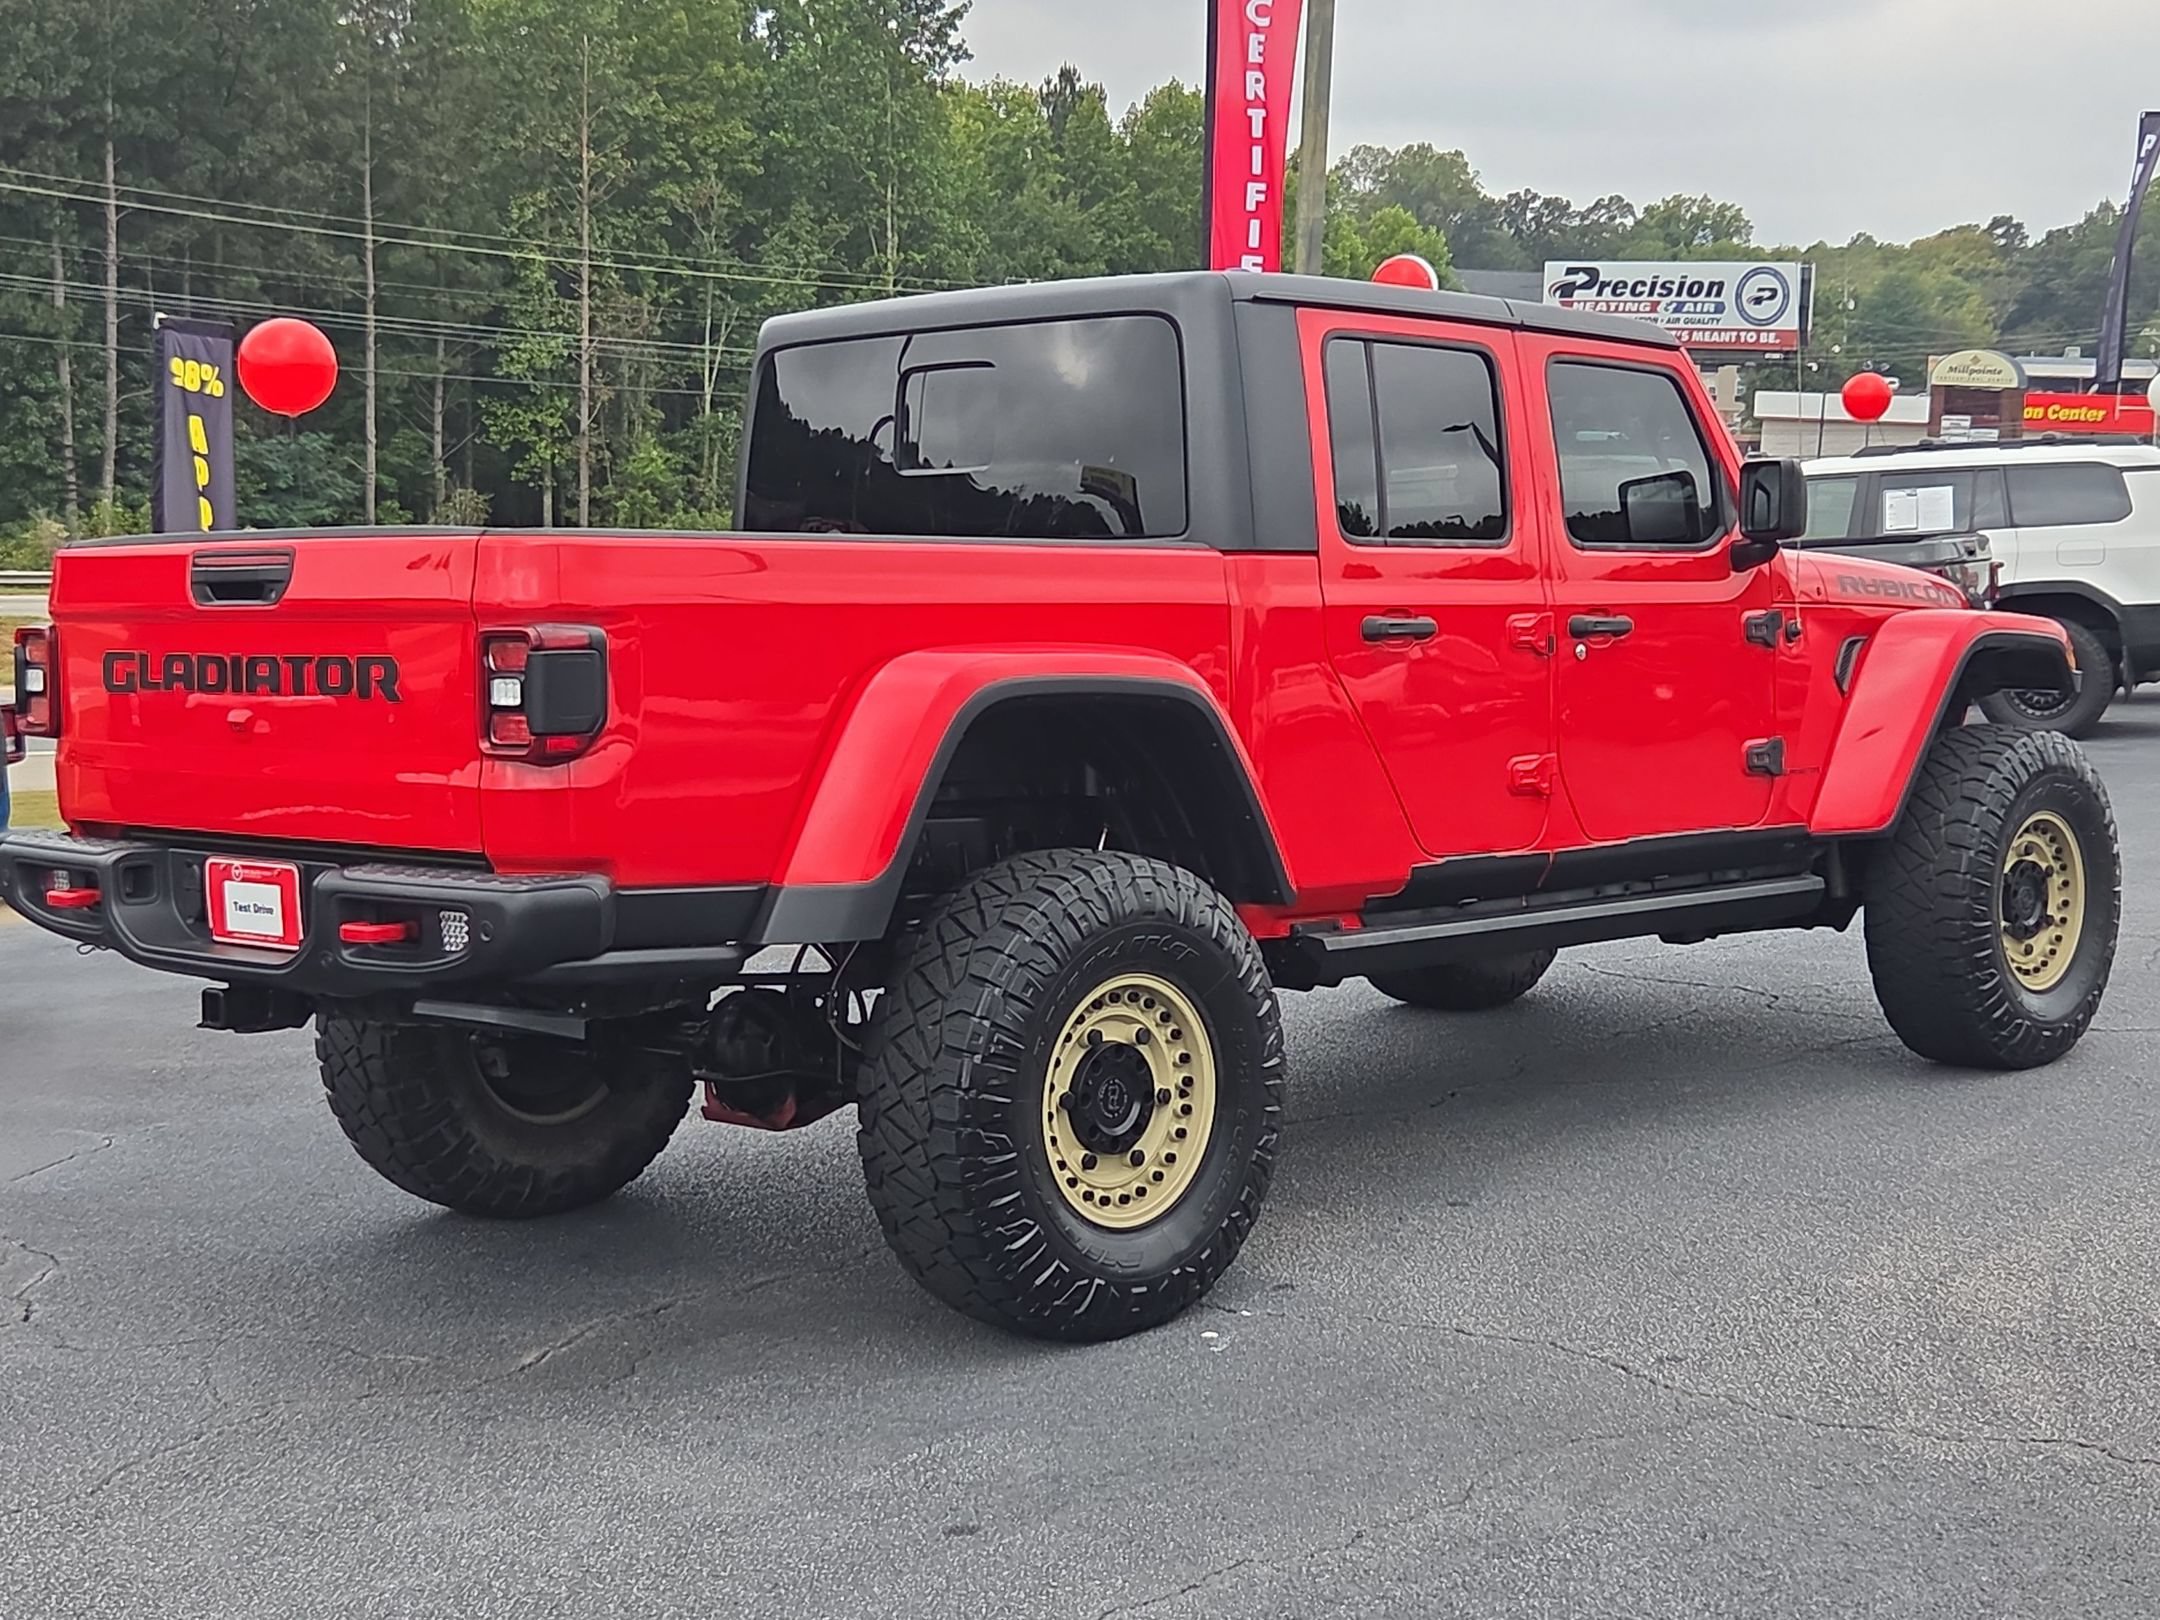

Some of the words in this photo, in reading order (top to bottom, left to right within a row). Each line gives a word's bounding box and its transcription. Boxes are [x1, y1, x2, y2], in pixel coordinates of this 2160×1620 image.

[1549, 267, 1726, 298] Precision
[1571, 300, 1652, 313] HEATING
[1681, 301, 1716, 313] AIR
[1665, 317, 1681, 325] AIR
[1684, 317, 1722, 325] QUALITY
[1692, 331, 1737, 343] MEANT
[1739, 331, 1758, 343] TO
[1759, 332, 1781, 344] BE.
[169, 356, 225, 398] 98%
[1946, 365, 2004, 376] Millpointe
[2047, 403, 2108, 422] Center
[1836, 574, 1961, 608] RUBICON
[102, 649, 403, 703] GLADIATOR
[232, 900, 251, 913] Test
[252, 902, 275, 916] Drive
